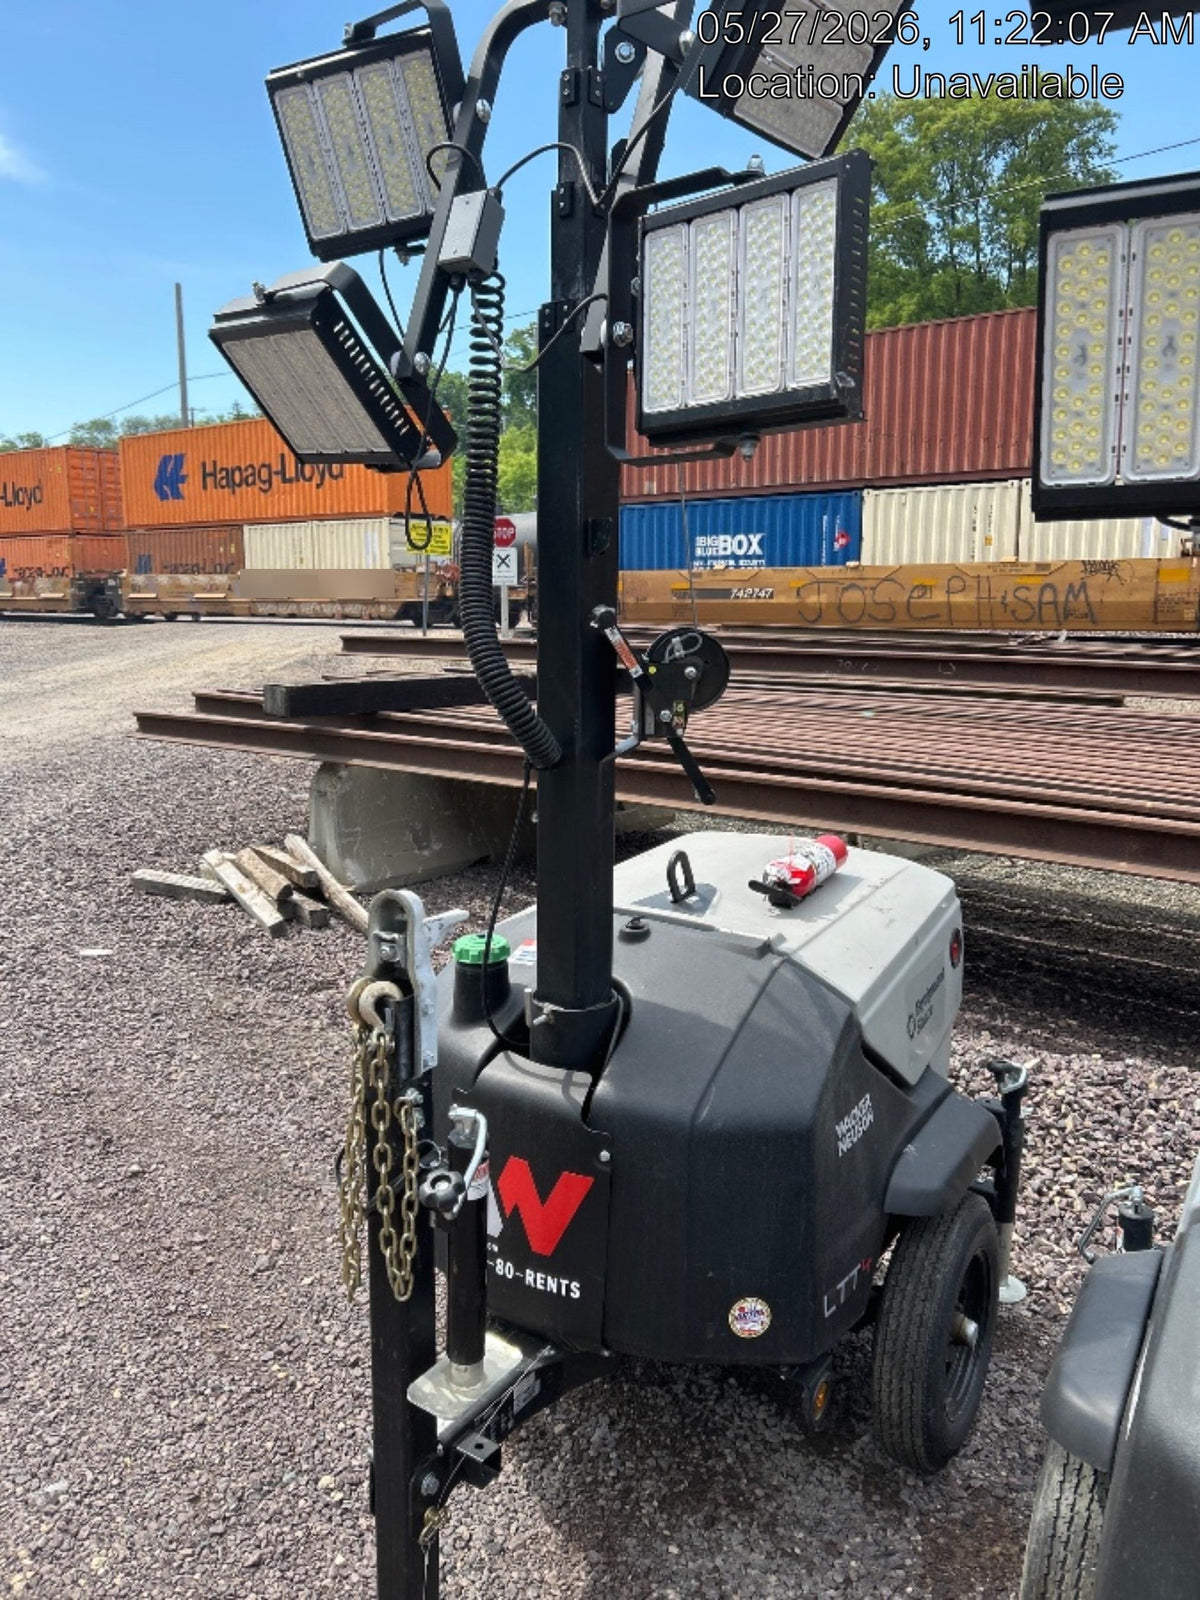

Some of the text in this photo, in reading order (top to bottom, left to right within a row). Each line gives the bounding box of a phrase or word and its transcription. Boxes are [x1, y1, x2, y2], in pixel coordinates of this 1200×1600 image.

[201, 452, 344, 495] Hapag-Lloyd
[718, 533, 766, 556] BOX
[1010, 579, 1098, 627] SAM
[837, 1110, 874, 1158] NEUSON
